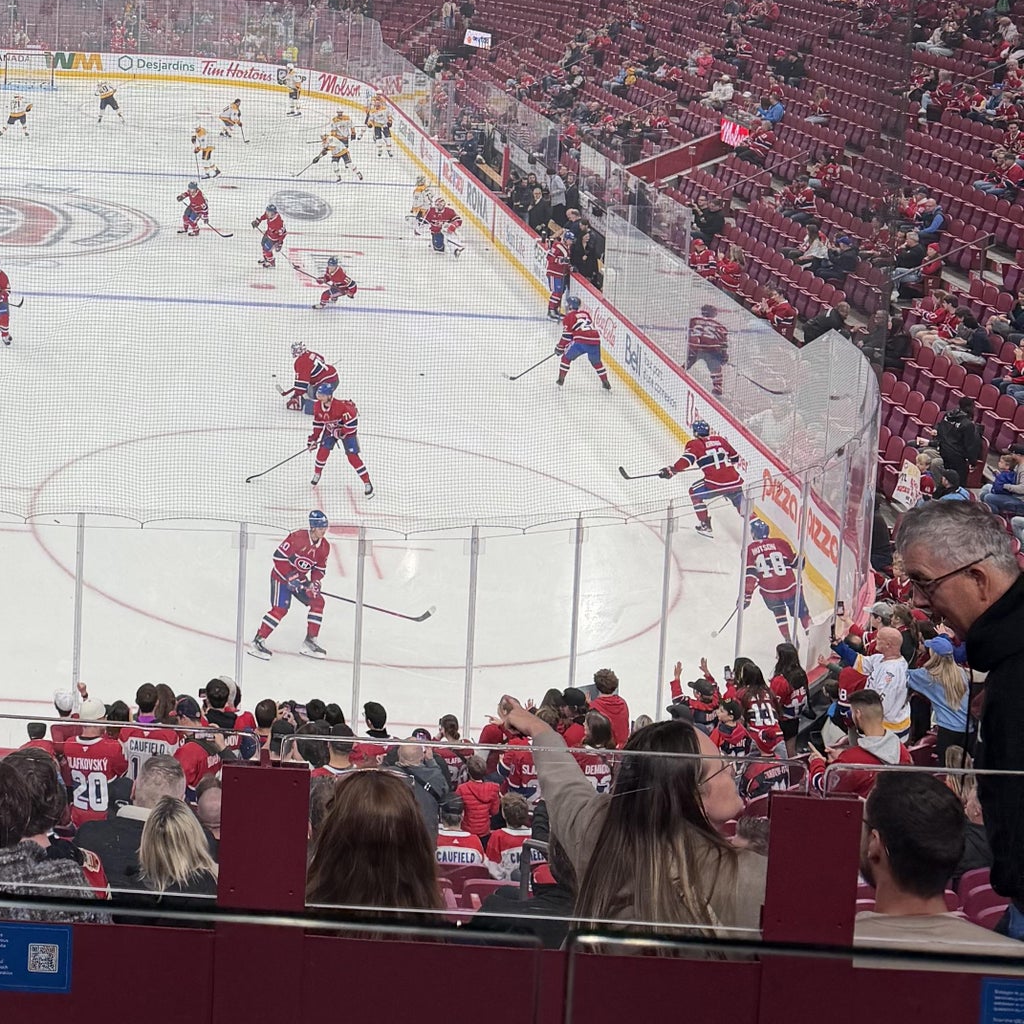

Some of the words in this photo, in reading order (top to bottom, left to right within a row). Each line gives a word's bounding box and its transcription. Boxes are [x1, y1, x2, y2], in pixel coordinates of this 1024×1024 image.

[44, 52, 103, 70] WM
[137, 58, 195, 73] Desjardins
[201, 60, 224, 77] Tim
[225, 62, 272, 82] Hortons
[318, 73, 361, 97] Molson
[625, 333, 642, 376] Bell
[762, 468, 799, 524] pizza
[755, 552, 787, 579] 48
[129, 739, 165, 756] CAUFIELD
[585, 764, 611, 776] DEMIDO
[72, 770, 109, 812] 20
[437, 851, 476, 864] CAUFIELD
